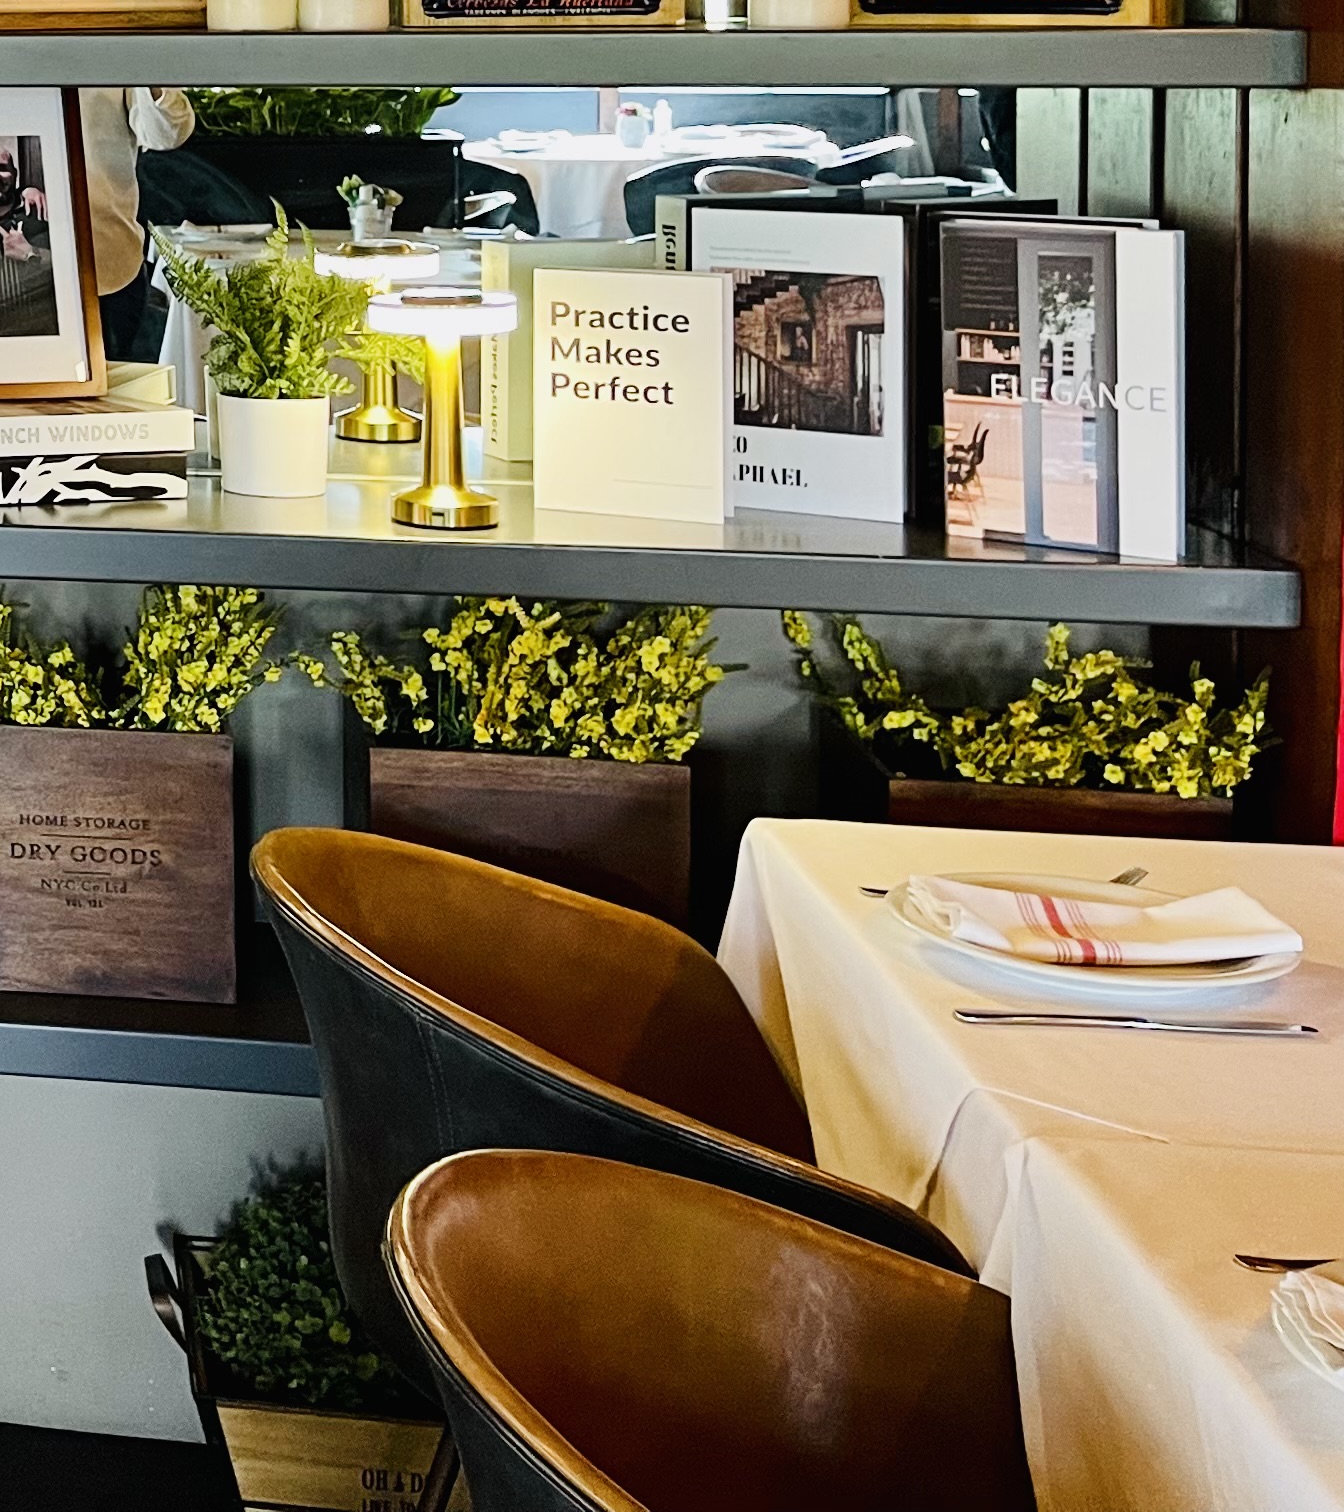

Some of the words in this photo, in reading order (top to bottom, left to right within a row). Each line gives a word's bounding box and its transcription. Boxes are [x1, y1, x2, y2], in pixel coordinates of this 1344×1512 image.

[550, 300, 691, 334] Practice
[550, 336, 661, 369] Makes
[550, 371, 676, 406] Perfect
[990, 373, 1168, 413] ELEGANCE
[47, 422, 151, 443] WINDOWS
[733, 463, 809, 489] PHAEL
[19, 813, 69, 827] HOME
[73, 815, 152, 831] STORAGE
[9, 841, 62, 862] DRY
[69, 845, 163, 867] GOODS
